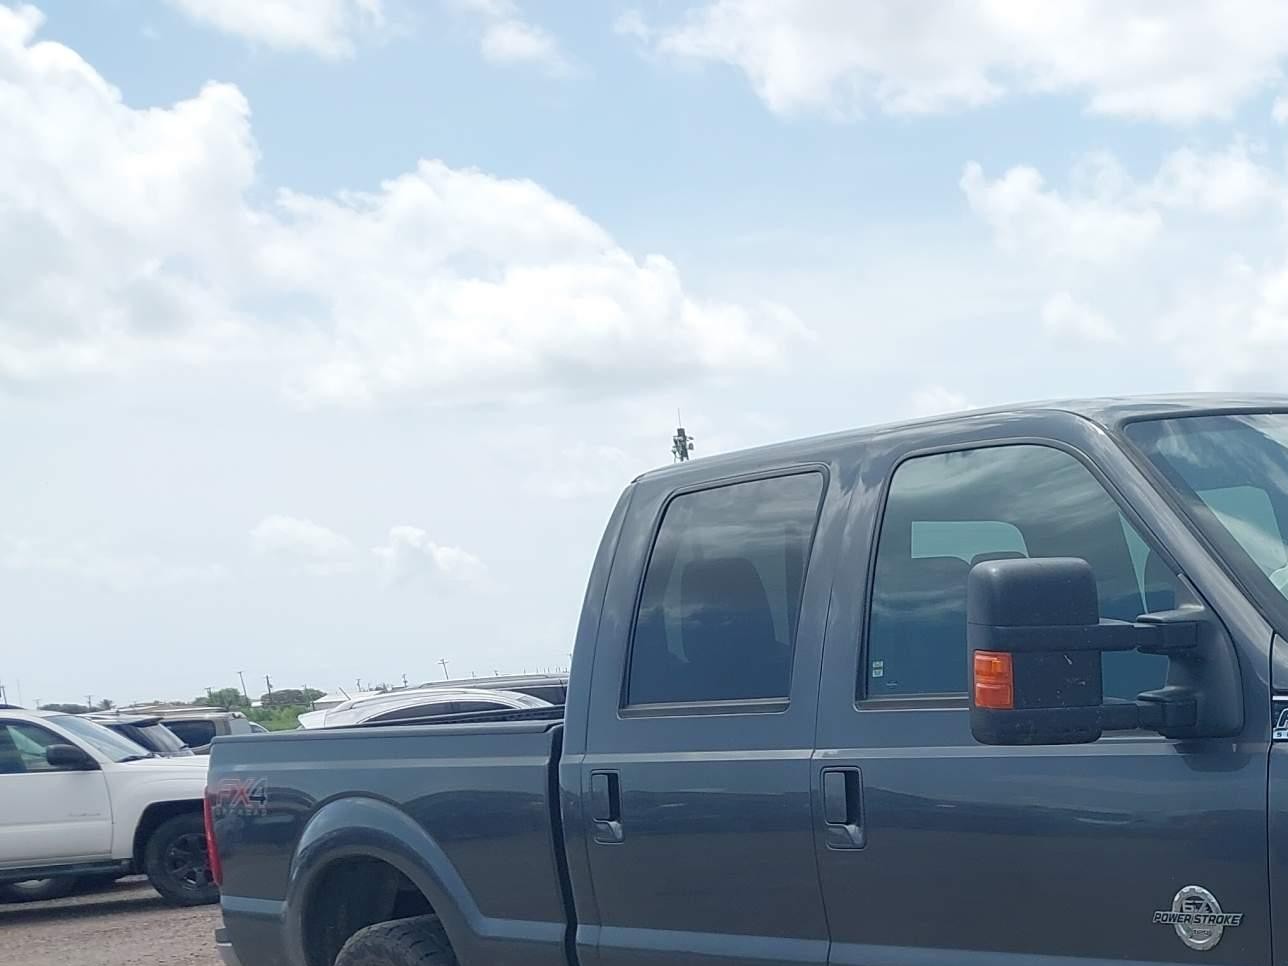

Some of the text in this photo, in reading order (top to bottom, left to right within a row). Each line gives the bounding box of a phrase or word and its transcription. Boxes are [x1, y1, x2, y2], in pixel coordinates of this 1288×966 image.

[213, 777, 268, 808] FX4
[1153, 911, 1243, 926] POWER STROKE
